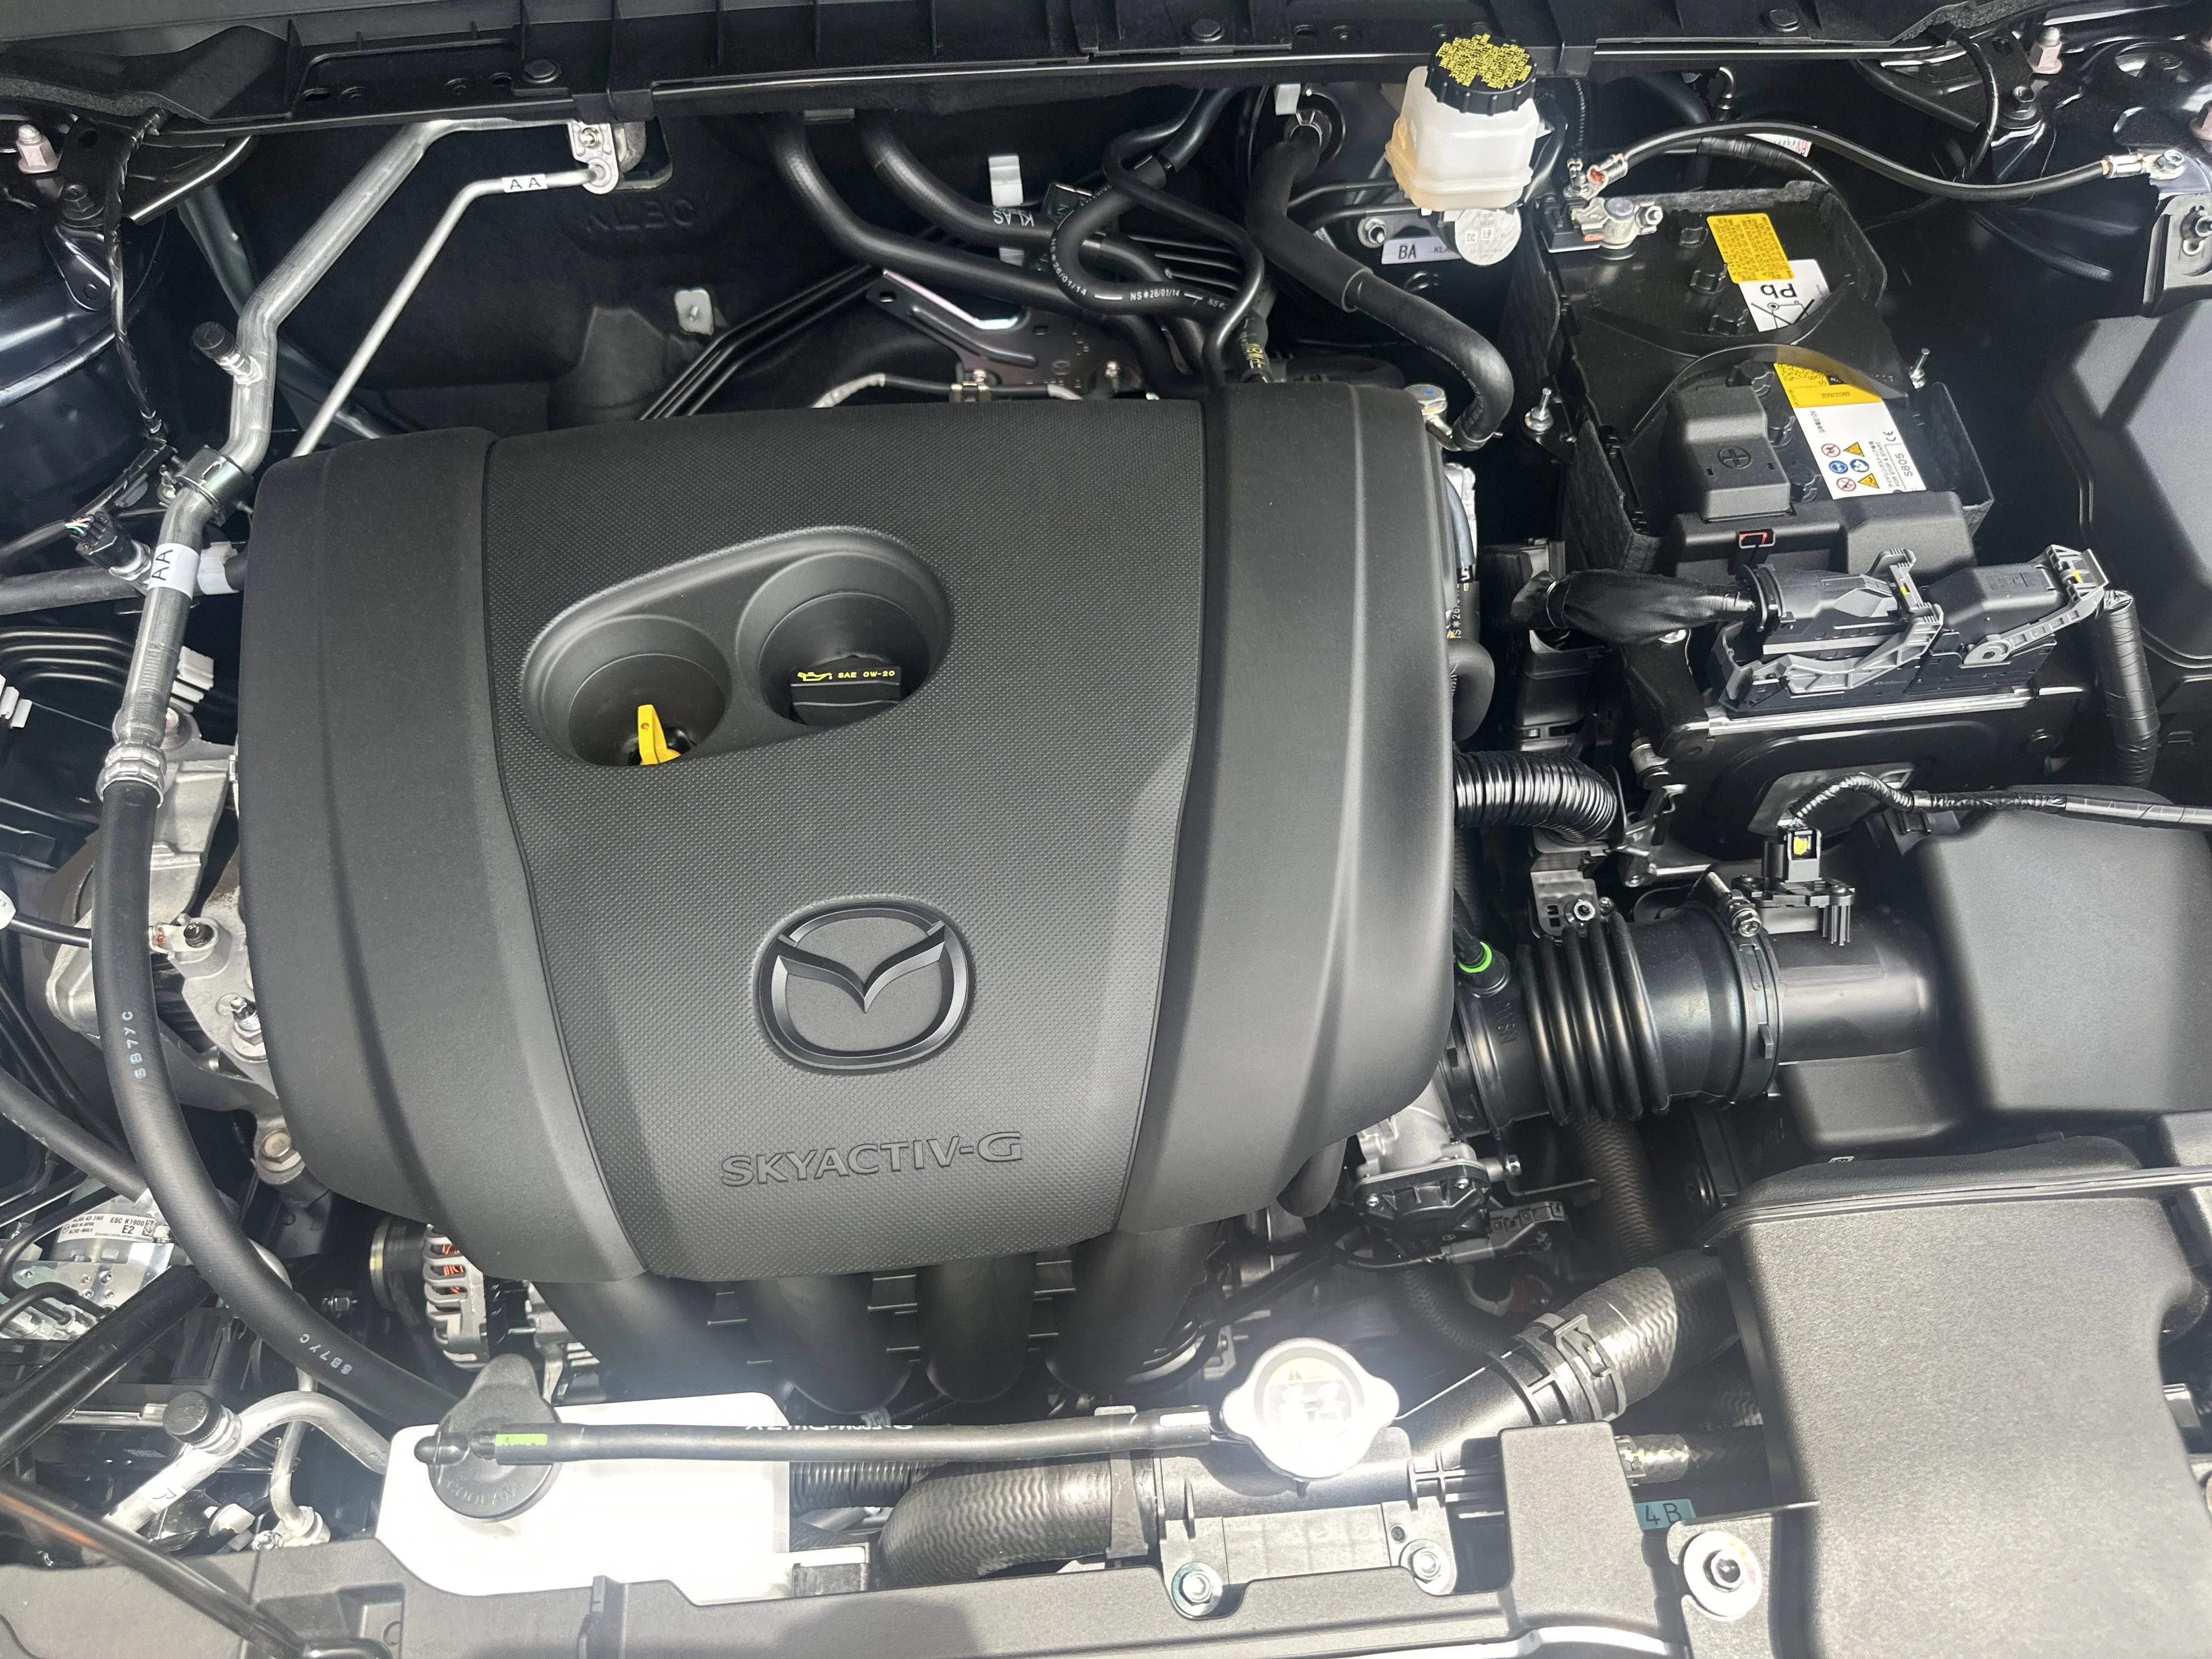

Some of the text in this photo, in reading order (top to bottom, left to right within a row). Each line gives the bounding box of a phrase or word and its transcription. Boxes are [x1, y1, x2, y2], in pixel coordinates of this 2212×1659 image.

[1398, 245, 1417, 260] BA
[1760, 283, 1797, 298] Pb
[721, 1131, 1023, 1187] SKYACTIV-G
[122, 1225, 135, 1234] E2
